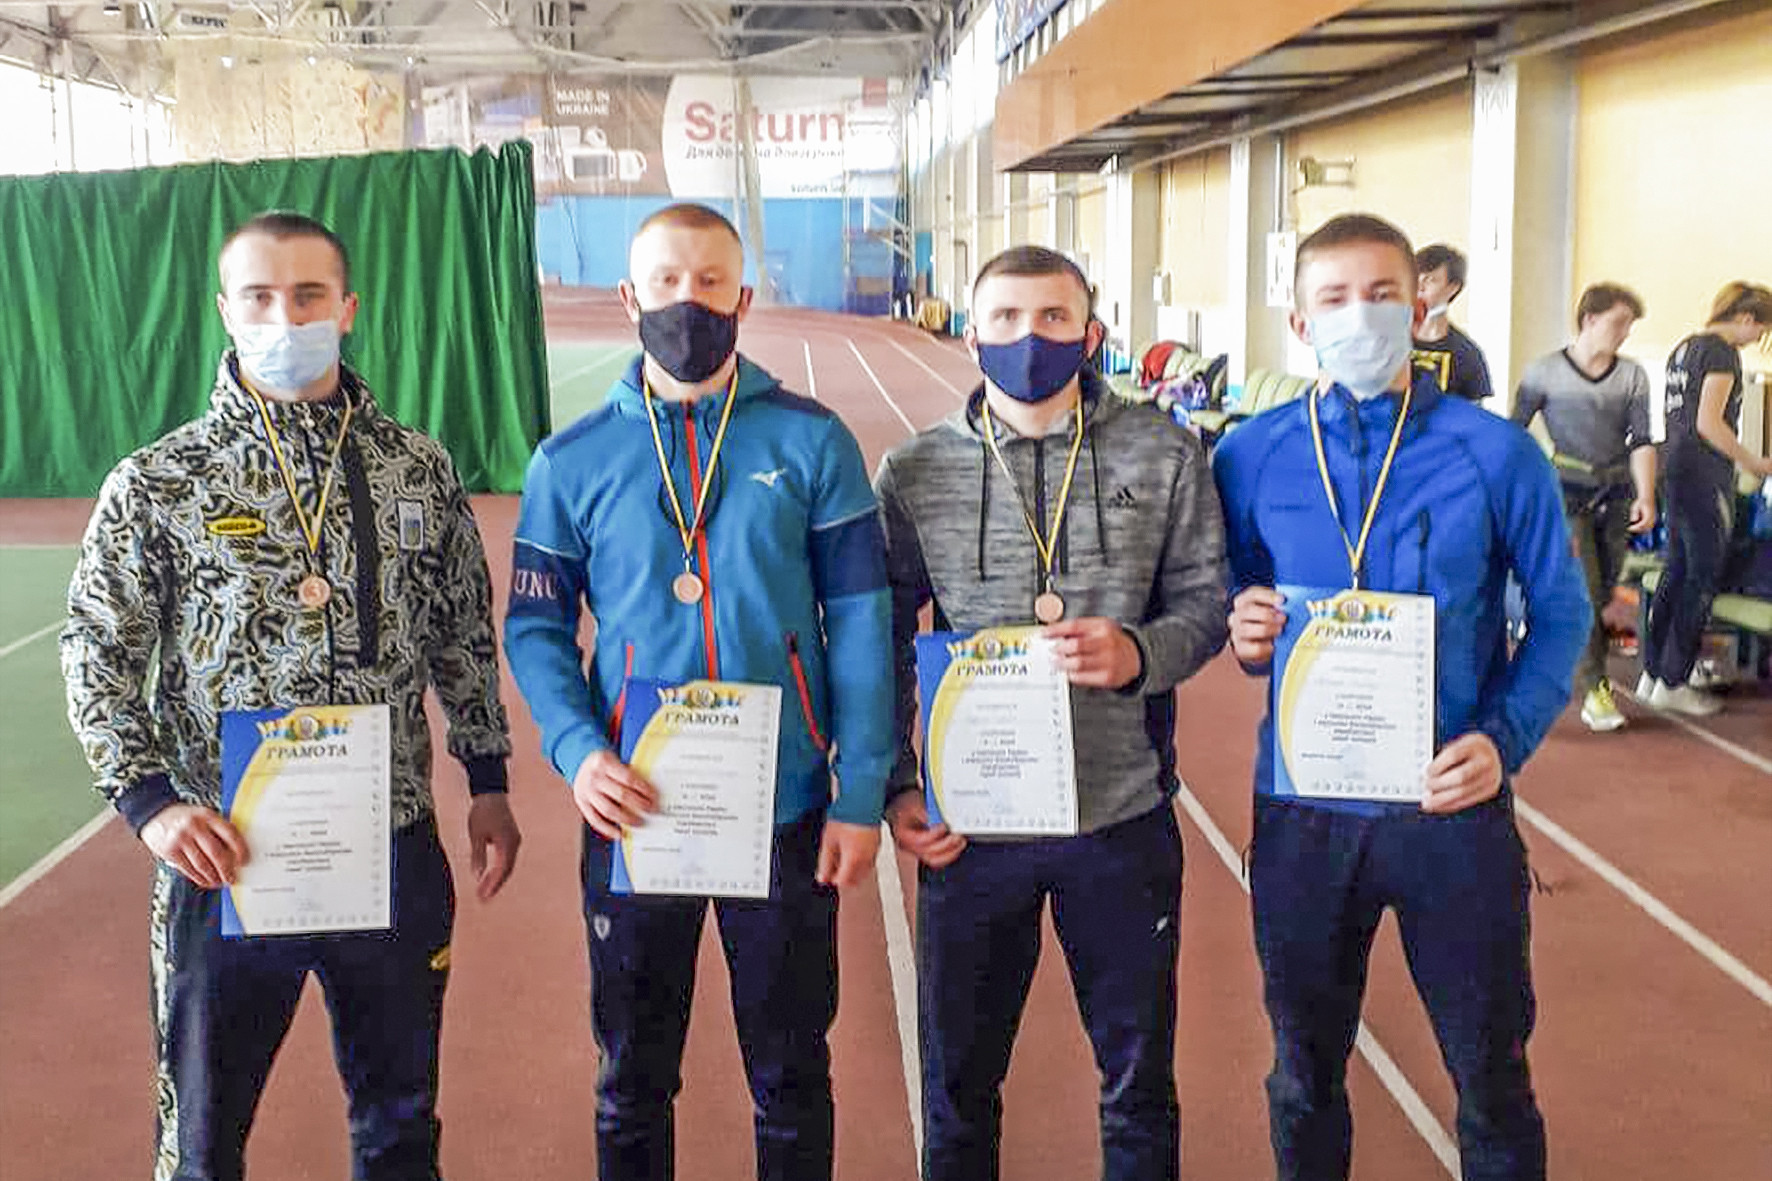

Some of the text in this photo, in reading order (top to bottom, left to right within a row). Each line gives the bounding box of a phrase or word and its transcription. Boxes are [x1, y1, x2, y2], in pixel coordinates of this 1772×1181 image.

[556, 89, 610, 102] MADE IN
[556, 104, 609, 116] UKRAINE
[684, 101, 844, 143] Saturn
[1315, 625, 1392, 641] ГРАМОТА
[956, 664, 1028, 677] ГРАМОТА
[664, 711, 740, 726] ГРАМОТА
[266, 742, 349, 760] ГРАМОТА
